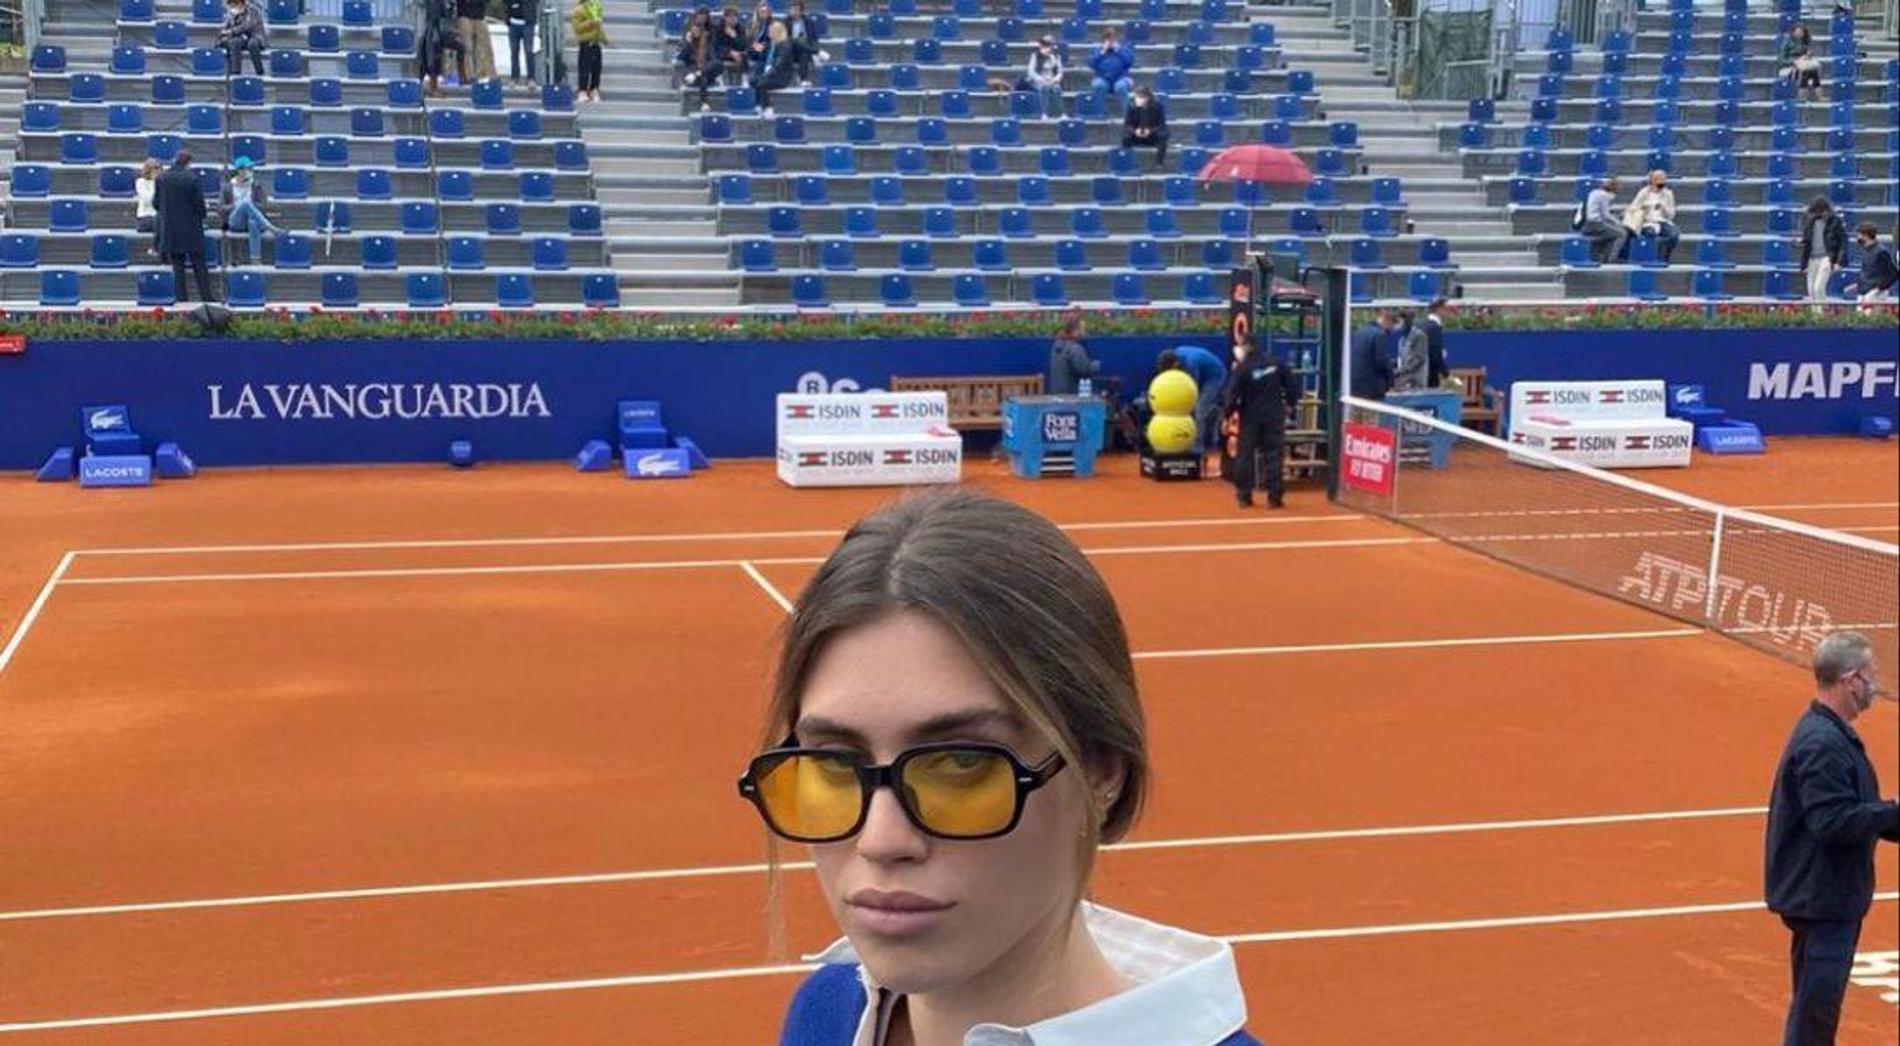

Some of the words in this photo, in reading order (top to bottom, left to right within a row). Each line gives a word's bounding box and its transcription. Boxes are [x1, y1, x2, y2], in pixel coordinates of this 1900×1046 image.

[1748, 362, 1898, 399] MAPF
[207, 383, 266, 419] LA
[264, 382, 552, 419] VANGUARDIA
[1553, 391, 1591, 404] ISDIN
[1627, 390, 1663, 403] ISDIN
[819, 404, 861, 419] ISDIN
[903, 402, 945, 417] ISDIN
[1579, 436, 1617, 450] ISDIN
[1653, 435, 1689, 449] ISDIN
[832, 451, 874, 466] ISDIN
[916, 449, 958, 464] ISDIN
[85, 467, 144, 478] LACOSTE
